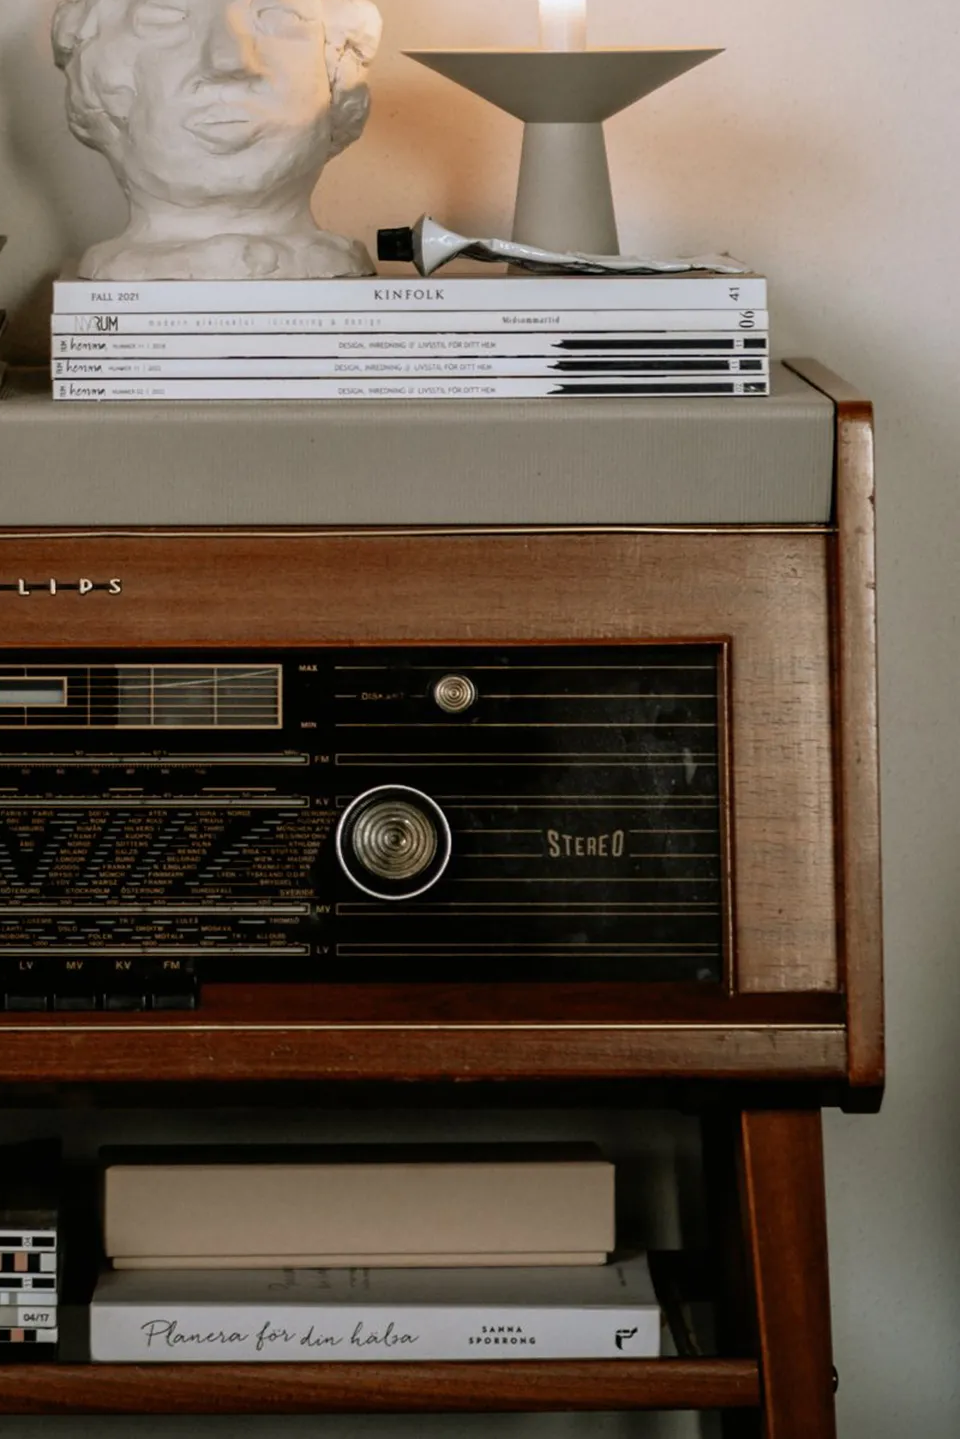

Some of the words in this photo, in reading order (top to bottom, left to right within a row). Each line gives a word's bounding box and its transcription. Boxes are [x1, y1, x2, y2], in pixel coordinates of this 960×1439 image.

[91, 293, 113, 301] FALL
[118, 293, 139, 301] 2021
[374, 289, 445, 300] KINFOLK
[728, 287, 740, 302] 41
[738, 310, 755, 329] 06
[70, 338, 107, 351] hemma
[66, 359, 103, 374] hemma
[69, 383, 106, 396] hemma
[298, 664, 318, 672] MAX
[300, 721, 317, 729] MIN
[314, 755, 330, 763] FM
[315, 798, 329, 806] KV
[547, 828, 624, 858] STEREO
[316, 905, 331, 913] MV
[317, 946, 329, 954] LV
[19, 961, 34, 970] LV
[66, 961, 84, 970] MV
[115, 961, 132, 970] KV
[163, 961, 180, 970] FM
[23, 1313, 49, 1322] 04/17
[140, 1319, 249, 1347] Planera
[255, 1321, 296, 1351] för
[300, 1326, 343, 1347] din
[468, 1336, 536, 1345] SPORRONG
